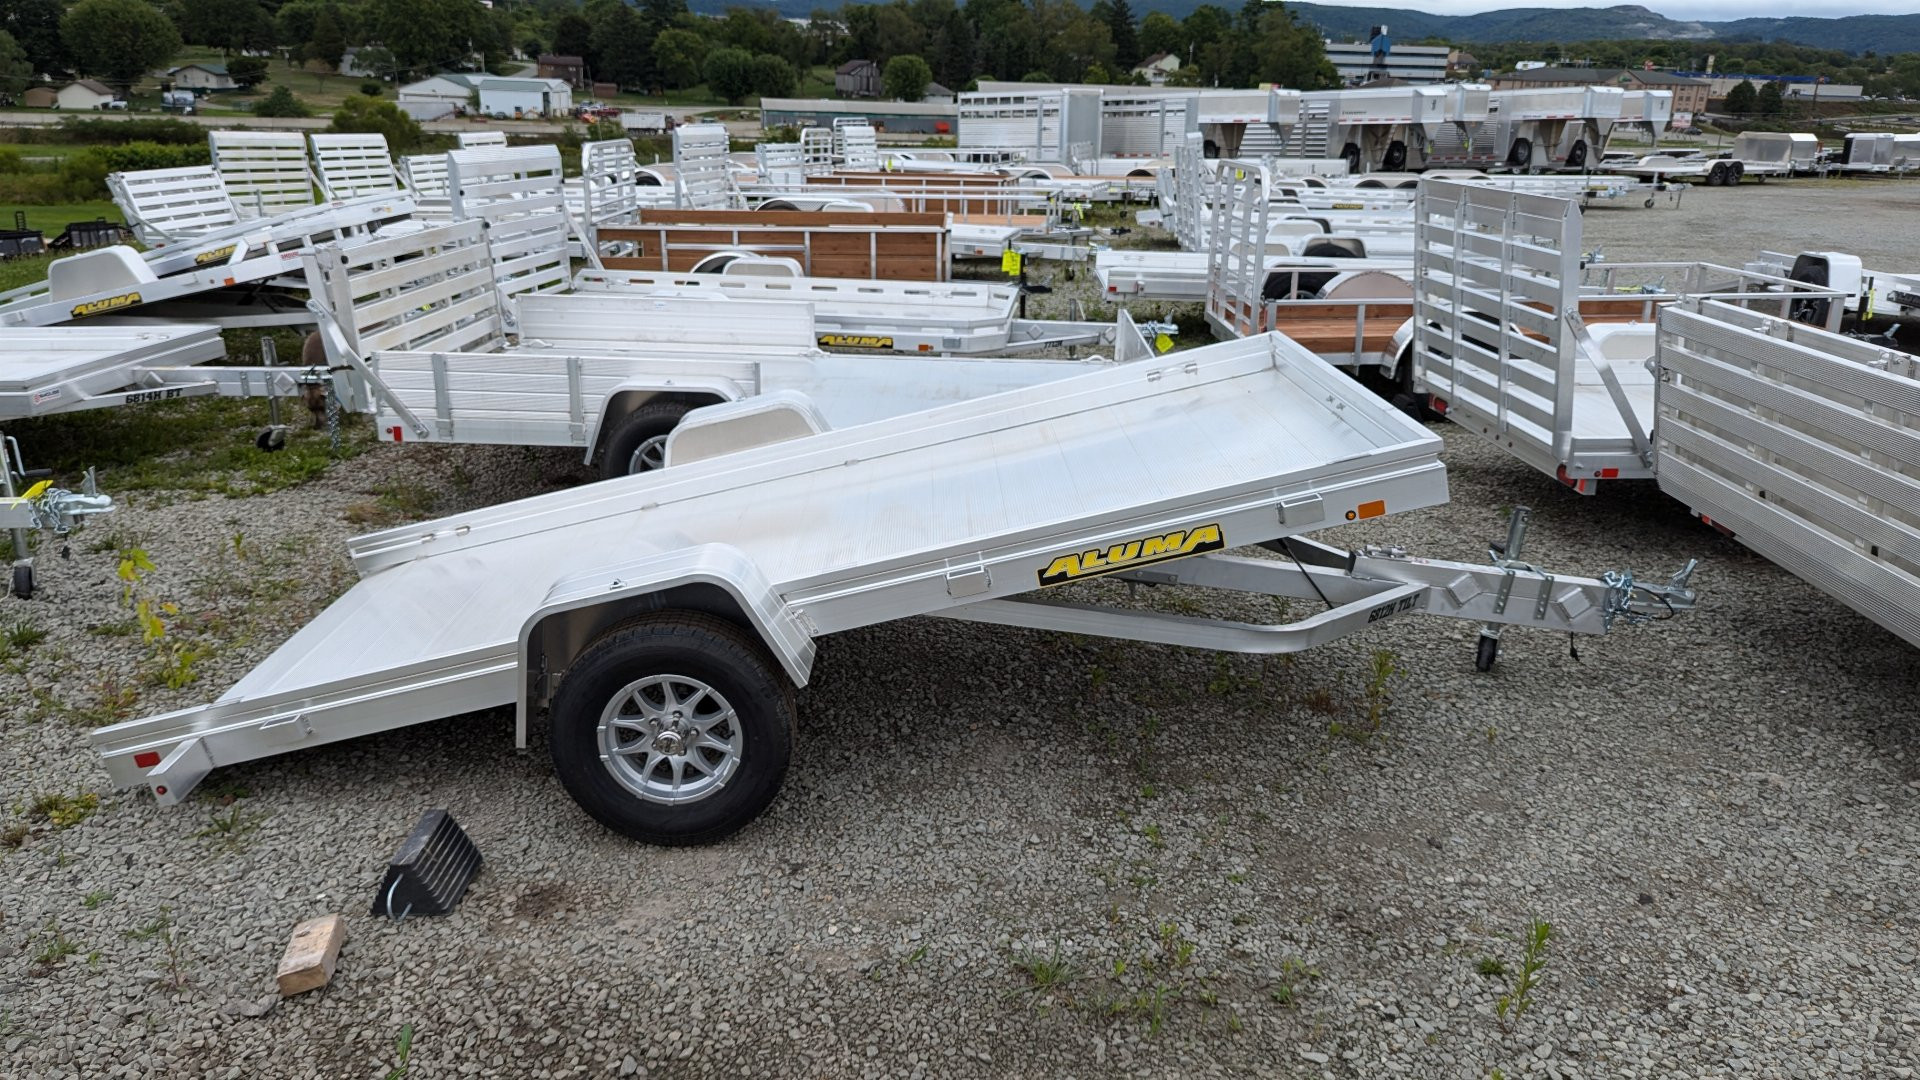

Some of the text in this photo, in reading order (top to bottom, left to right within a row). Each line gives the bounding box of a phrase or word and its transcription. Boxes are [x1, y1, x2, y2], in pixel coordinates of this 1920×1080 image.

[72, 292, 141, 316] ALUMA
[819, 335, 893, 348] ALUMA
[167, 388, 183, 398] BT
[1041, 523, 1221, 578] ALUMA
[1398, 593, 1420, 612] TILT
